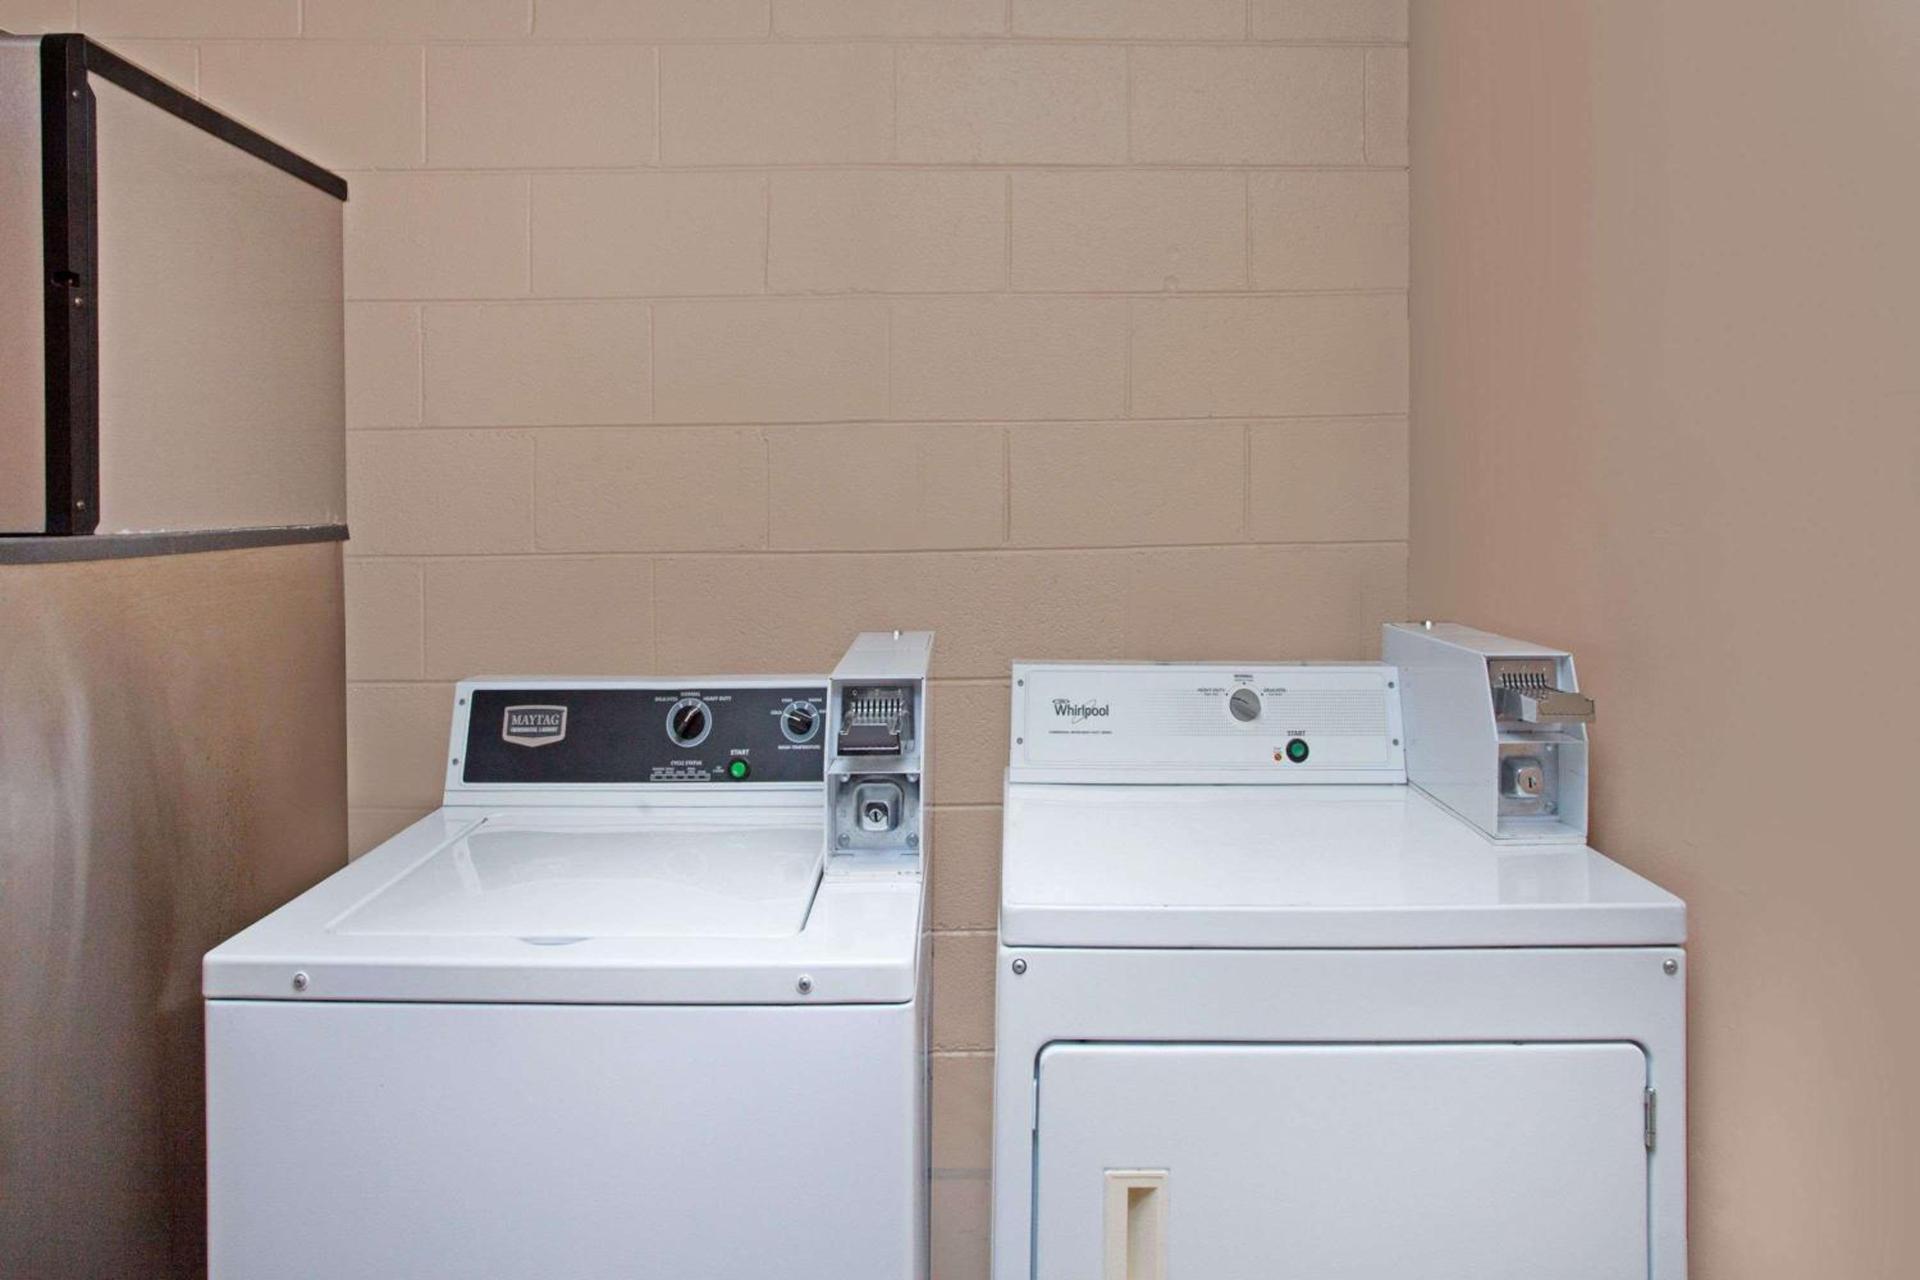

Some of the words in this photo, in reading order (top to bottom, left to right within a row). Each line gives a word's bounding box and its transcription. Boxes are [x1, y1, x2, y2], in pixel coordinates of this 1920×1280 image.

[1055, 704, 1109, 719] Whirlpool
[511, 713, 560, 726] MAYTAG
[730, 748, 750, 756] START
